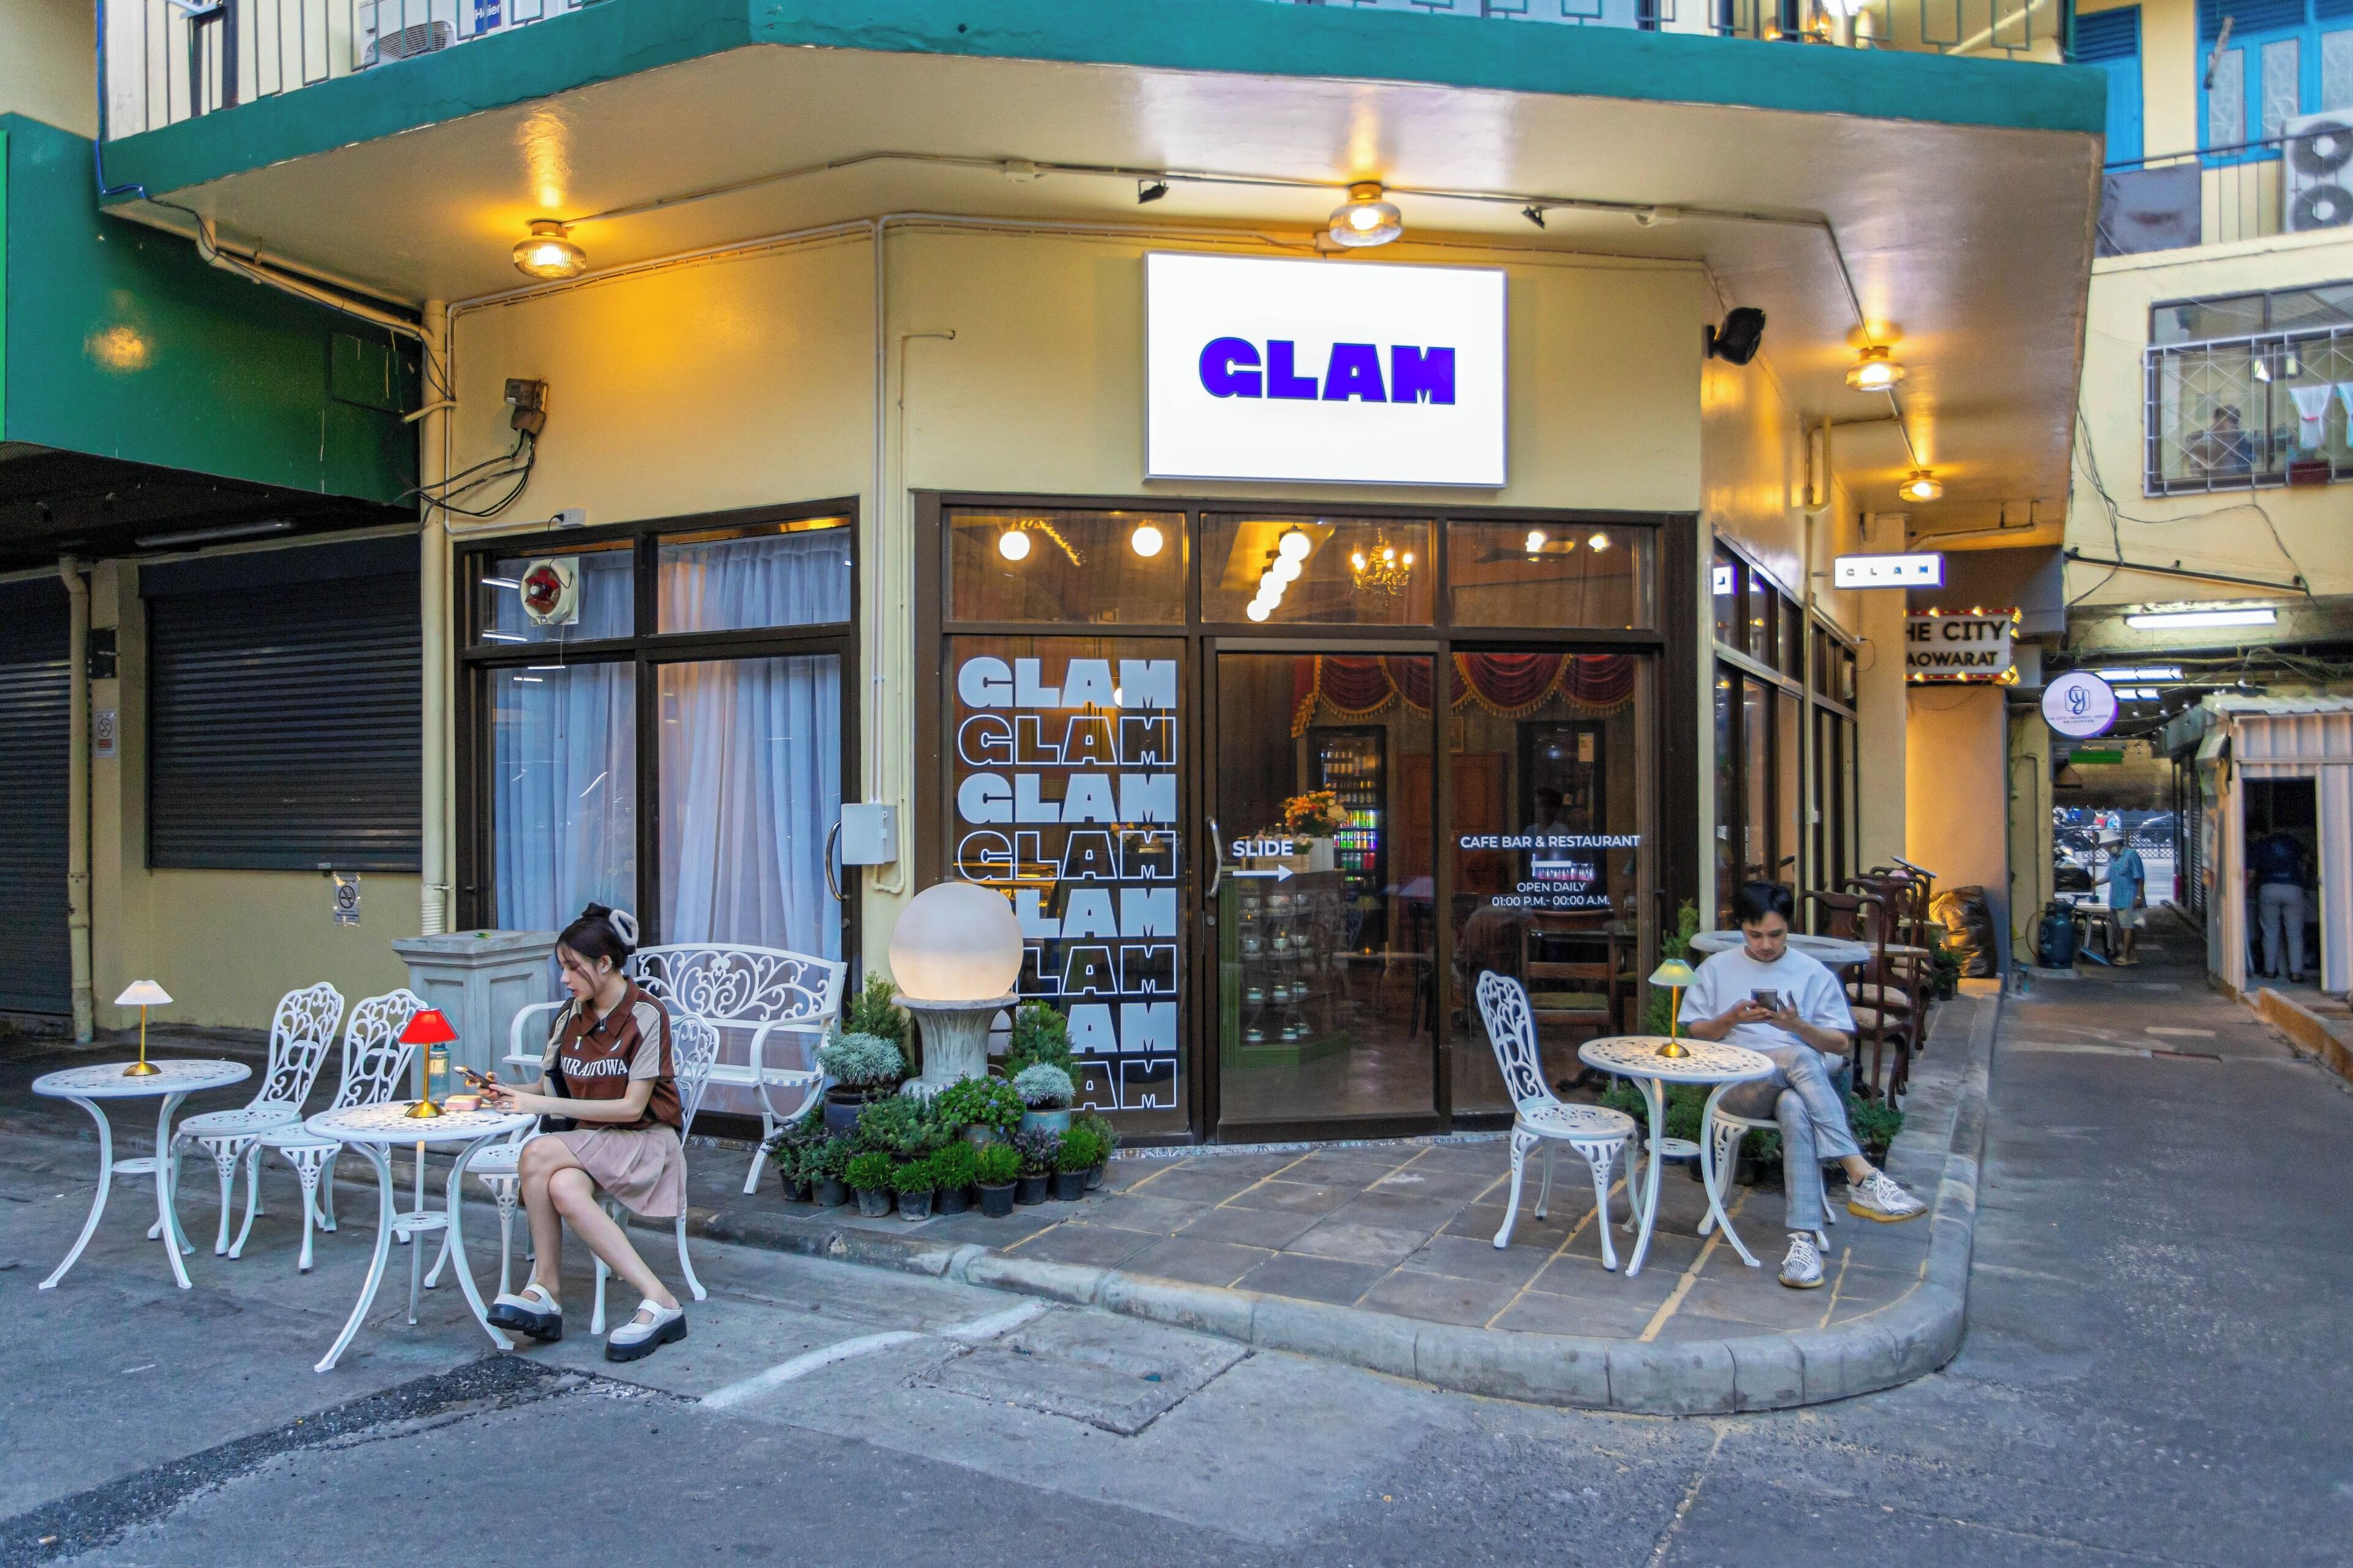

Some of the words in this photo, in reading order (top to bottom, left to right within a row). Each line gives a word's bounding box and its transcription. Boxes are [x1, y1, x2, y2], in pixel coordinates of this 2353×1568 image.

[1199, 336, 1455, 405] GLAM
[1942, 621, 2005, 641] CITY
[958, 656, 1176, 708] GLAM
[1907, 651, 1997, 667] AOWARAT
[958, 714, 1176, 766] GLAM
[958, 773, 1176, 824] GLAM
[958, 830, 1176, 881] GLAM
[1232, 839, 1293, 857] SLIDE
[1460, 836, 1499, 849] CAFE
[1502, 836, 1531, 849] BAR
[1535, 836, 1545, 847] &
[1548, 835, 1640, 847] RESTAURANT
[1492, 896, 1520, 907] 01:00
[1586, 895, 1610, 906] A.M.
[1517, 882, 1550, 893] OPEN
[1553, 882, 1585, 892] DAILY
[1015, 888, 1176, 938] LAM
[1015, 944, 1176, 995] LAM
